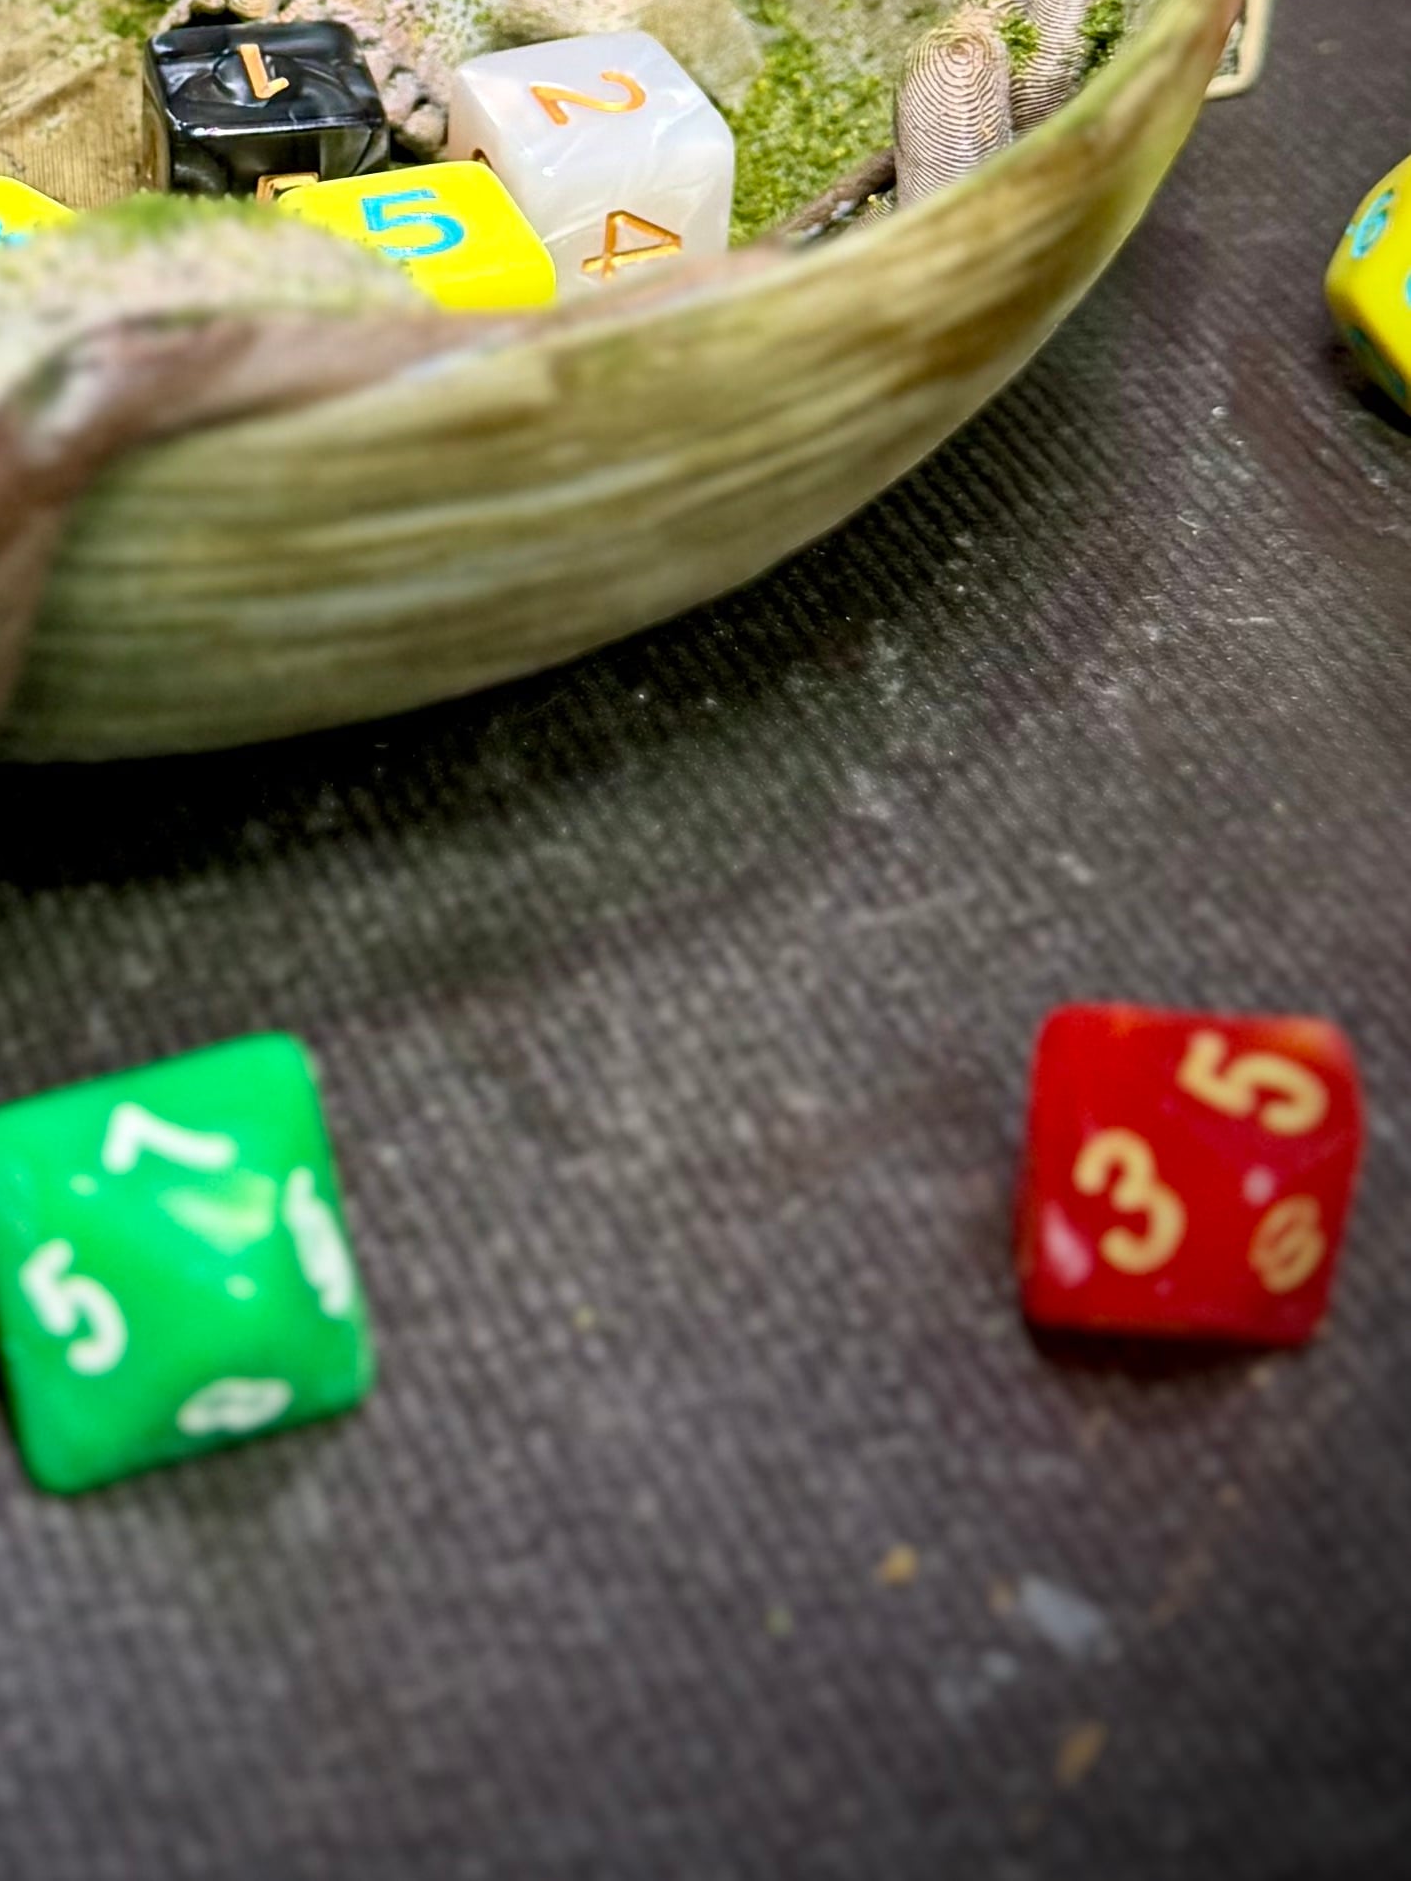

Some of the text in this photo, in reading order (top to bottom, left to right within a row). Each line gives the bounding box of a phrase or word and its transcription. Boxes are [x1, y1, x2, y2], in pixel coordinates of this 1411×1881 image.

[237, 43, 290, 99] 1
[530, 70, 647, 125] 2
[361, 189, 465, 258] 5
[582, 209, 682, 277] 4
[1176, 1030, 1329, 1136] 5
[102, 1102, 239, 1175] 7
[1073, 1126, 1187, 1276] 3
[20, 1238, 127, 1375] 5
